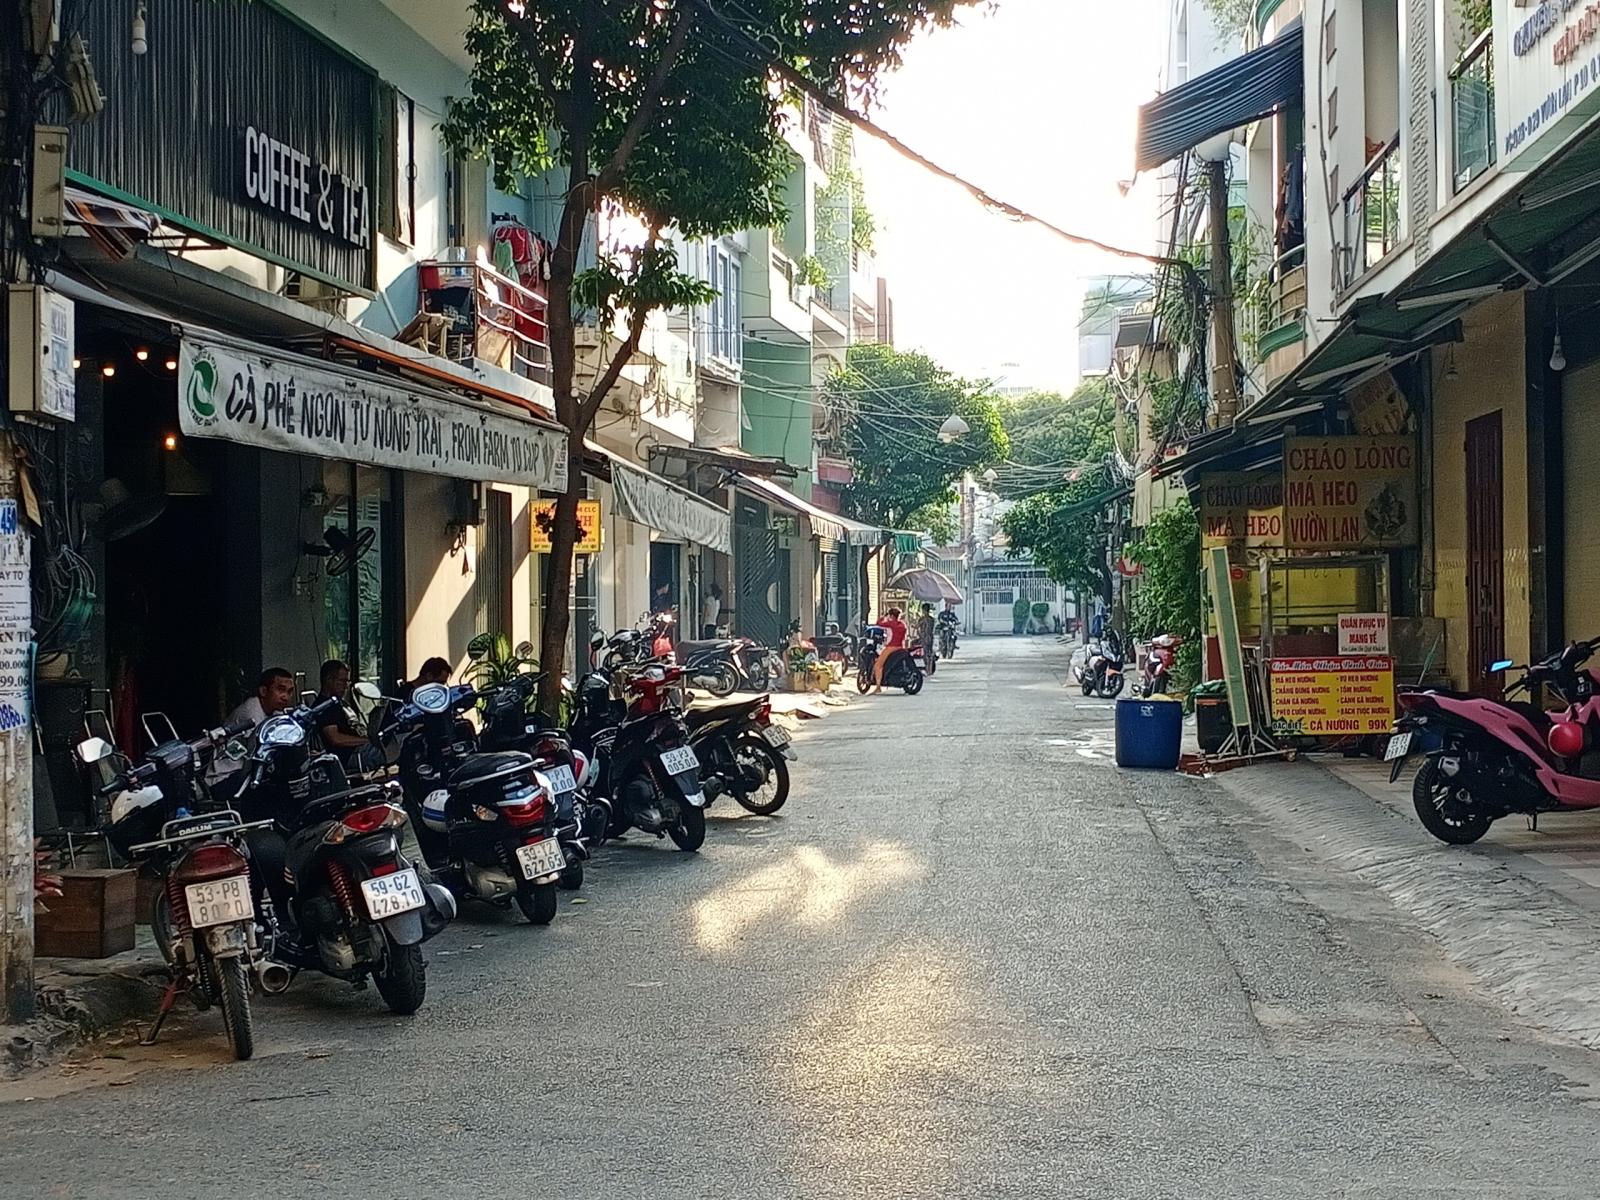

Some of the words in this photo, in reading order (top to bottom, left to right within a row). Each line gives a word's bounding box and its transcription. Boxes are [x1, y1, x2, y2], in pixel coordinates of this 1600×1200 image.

[245, 126, 310, 223] COFFEE
[317, 163, 334, 234] &
[341, 173, 370, 250] TEA
[225, 363, 257, 424] CÀ
[262, 376, 296, 434] PHÊ
[300, 391, 346, 444] NGON
[351, 389, 371, 445] TỪ
[373, 395, 411, 454] NÔNG
[452, 421, 480, 465] FROM
[483, 429, 510, 471] FARM
[510, 437, 520, 473] TO
[524, 438, 539, 476] CUP
[1290, 442, 1347, 471] CHÁO
[1354, 440, 1411, 470] LÒNG
[1207, 479, 1242, 507] CHÁO
[1247, 478, 1282, 506] LÒNG
[1289, 475, 1316, 507] MÁ
[1322, 480, 1358, 507] HEO
[1207, 510, 1236, 537] MÁ
[1243, 514, 1281, 537] HEO
[1291, 511, 1327, 542] VƯỜN
[1332, 516, 1360, 542] LAN
[1341, 616, 1358, 629] QUÁN
[1359, 618, 1376, 630] PHỤC
[1377, 617, 1386, 630] VỤ
[1349, 633, 1368, 644] MANG
[1310, 717, 1323, 731] CÁ
[1368, 718, 1388, 730] 99K
[667, 756, 697, 774] 005.00
[524, 853, 563, 877] 622.65
[195, 880, 240, 904] 53-P8
[370, 874, 411, 897] 59-G2
